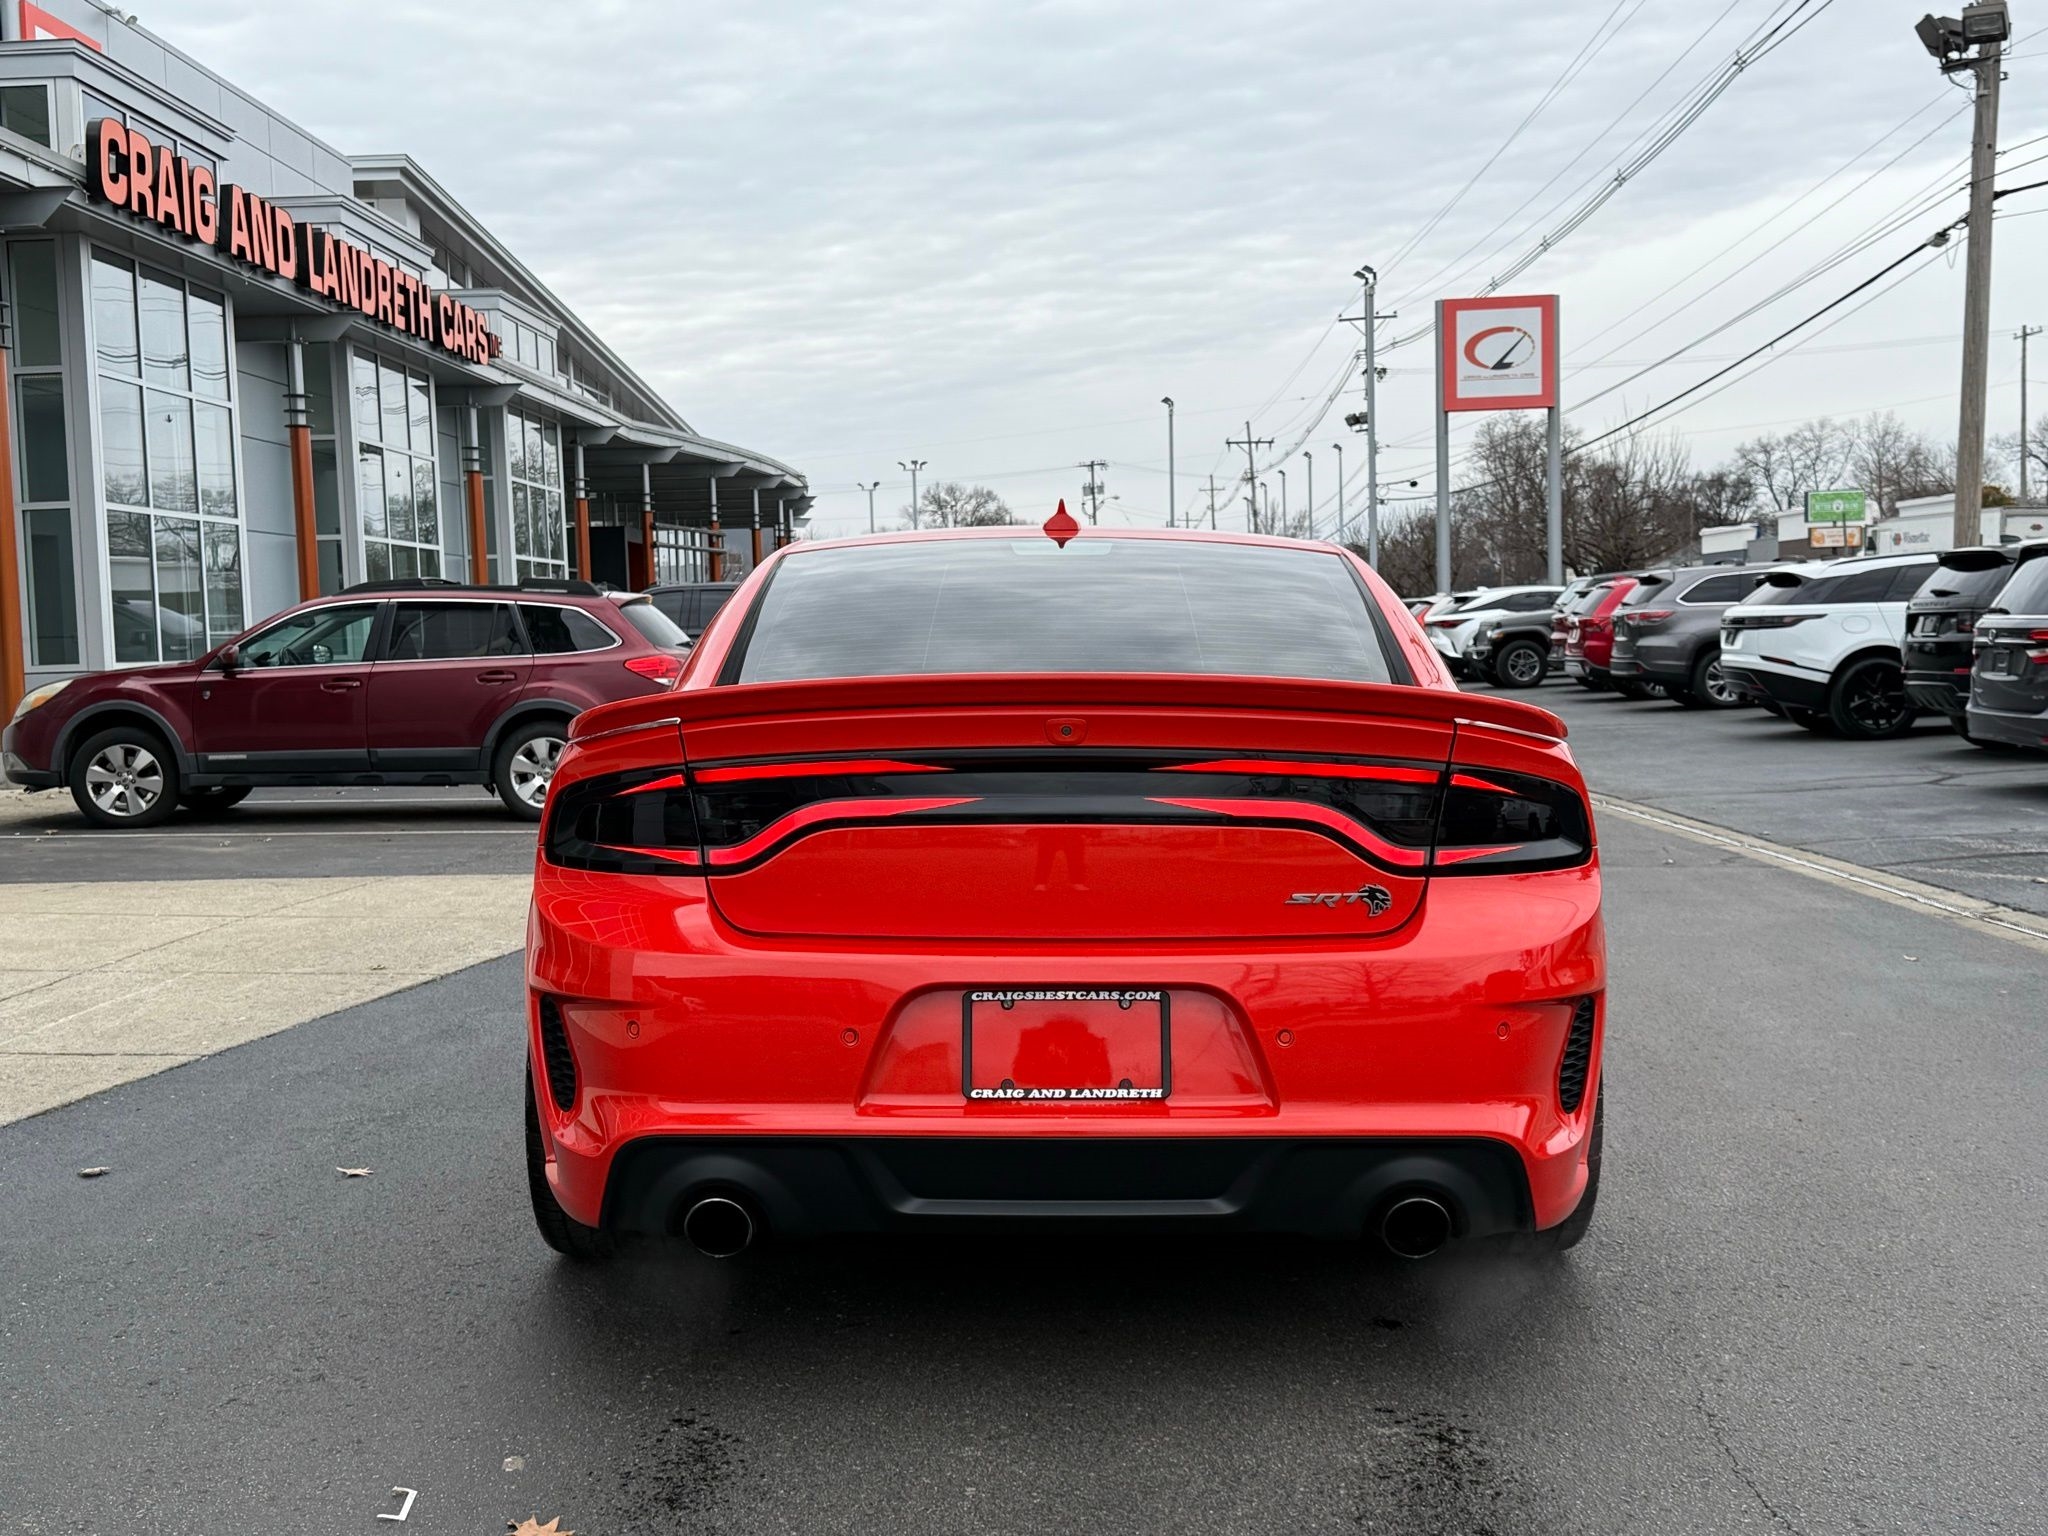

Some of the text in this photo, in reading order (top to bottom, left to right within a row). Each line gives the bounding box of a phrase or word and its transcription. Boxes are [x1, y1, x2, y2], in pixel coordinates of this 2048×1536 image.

[96, 117, 217, 246] CRAIG
[228, 184, 297, 280] AND
[306, 222, 434, 341] LANDRETH
[438, 292, 489, 366] CARS
[1284, 892, 1369, 908] SRT
[971, 991, 1161, 1000] CRAIGSBESTCARS.COM
[970, 1088, 1163, 1099] CRAIG AND LANDRETH
